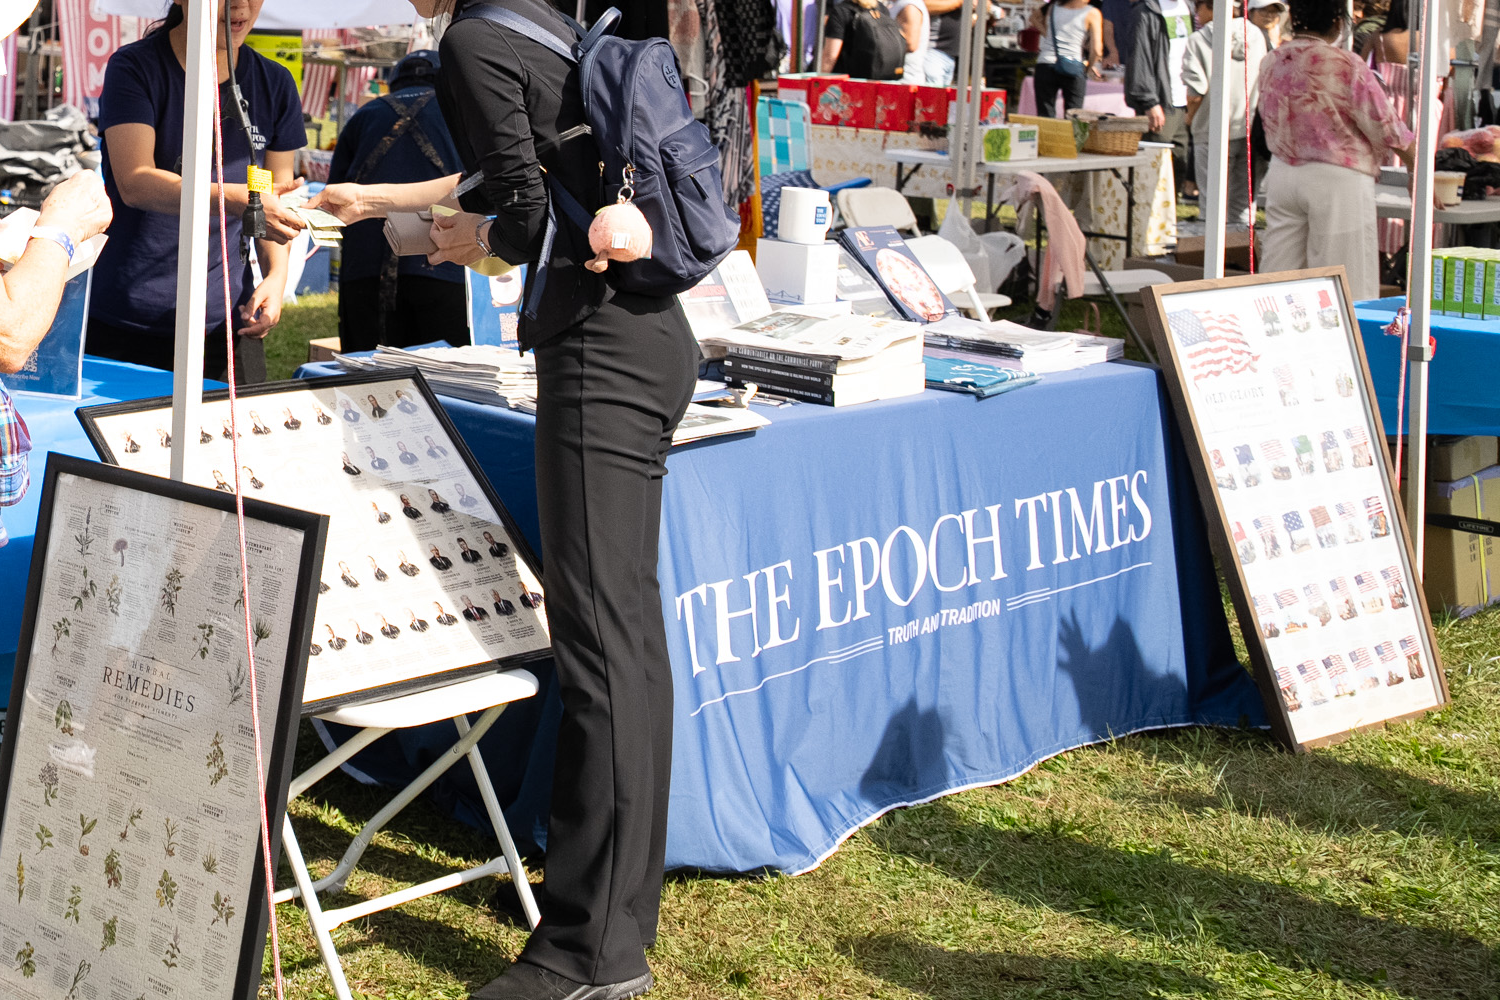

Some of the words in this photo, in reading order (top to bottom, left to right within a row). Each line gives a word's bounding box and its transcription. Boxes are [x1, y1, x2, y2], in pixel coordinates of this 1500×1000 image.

[809, 359, 823, 368] PARTY
[1205, 389, 1227, 405] OLD
[1229, 386, 1265, 402] GLORY
[675, 558, 800, 678] THE
[813, 503, 1007, 632] EPOCH
[1015, 469, 1152, 571] TIMES
[888, 619, 920, 646] TRUTH
[921, 612, 941, 634] AN
[940, 599, 1001, 627] TRADITION
[132, 660, 171, 680] HERBAL
[102, 665, 196, 713] REMEDIES
